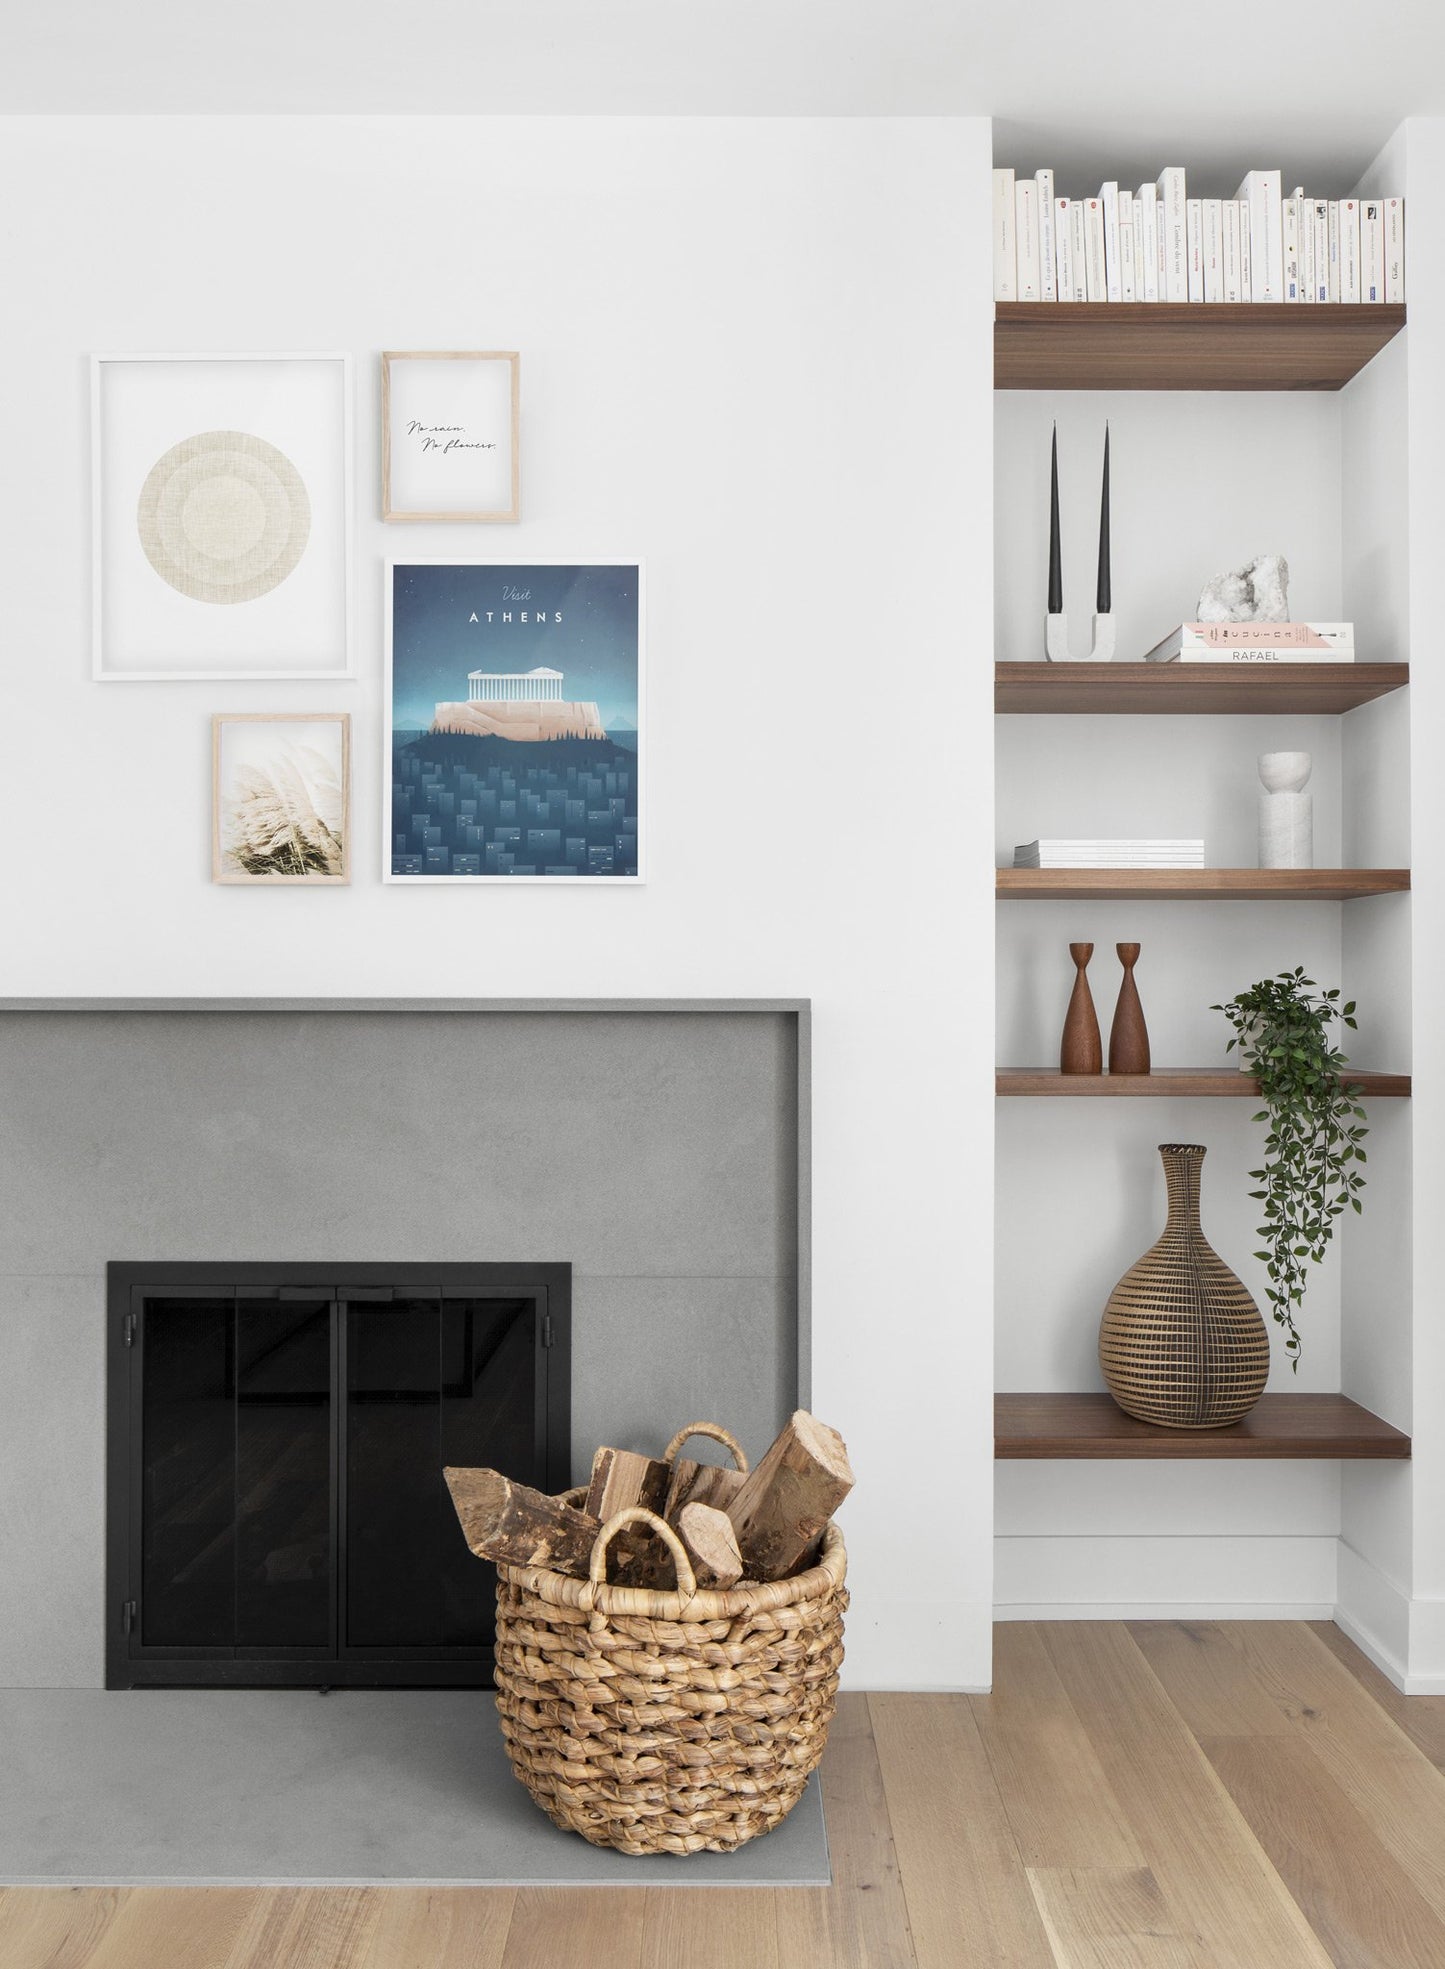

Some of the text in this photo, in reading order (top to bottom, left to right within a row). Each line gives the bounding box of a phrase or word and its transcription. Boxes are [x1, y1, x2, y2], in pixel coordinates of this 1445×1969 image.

[406, 420, 428, 435] No
[421, 437, 496, 454] No flowers.
[502, 585, 532, 601] Visit
[468, 611, 563, 623] ATHENS
[1232, 651, 1279, 661] RAFAEL
